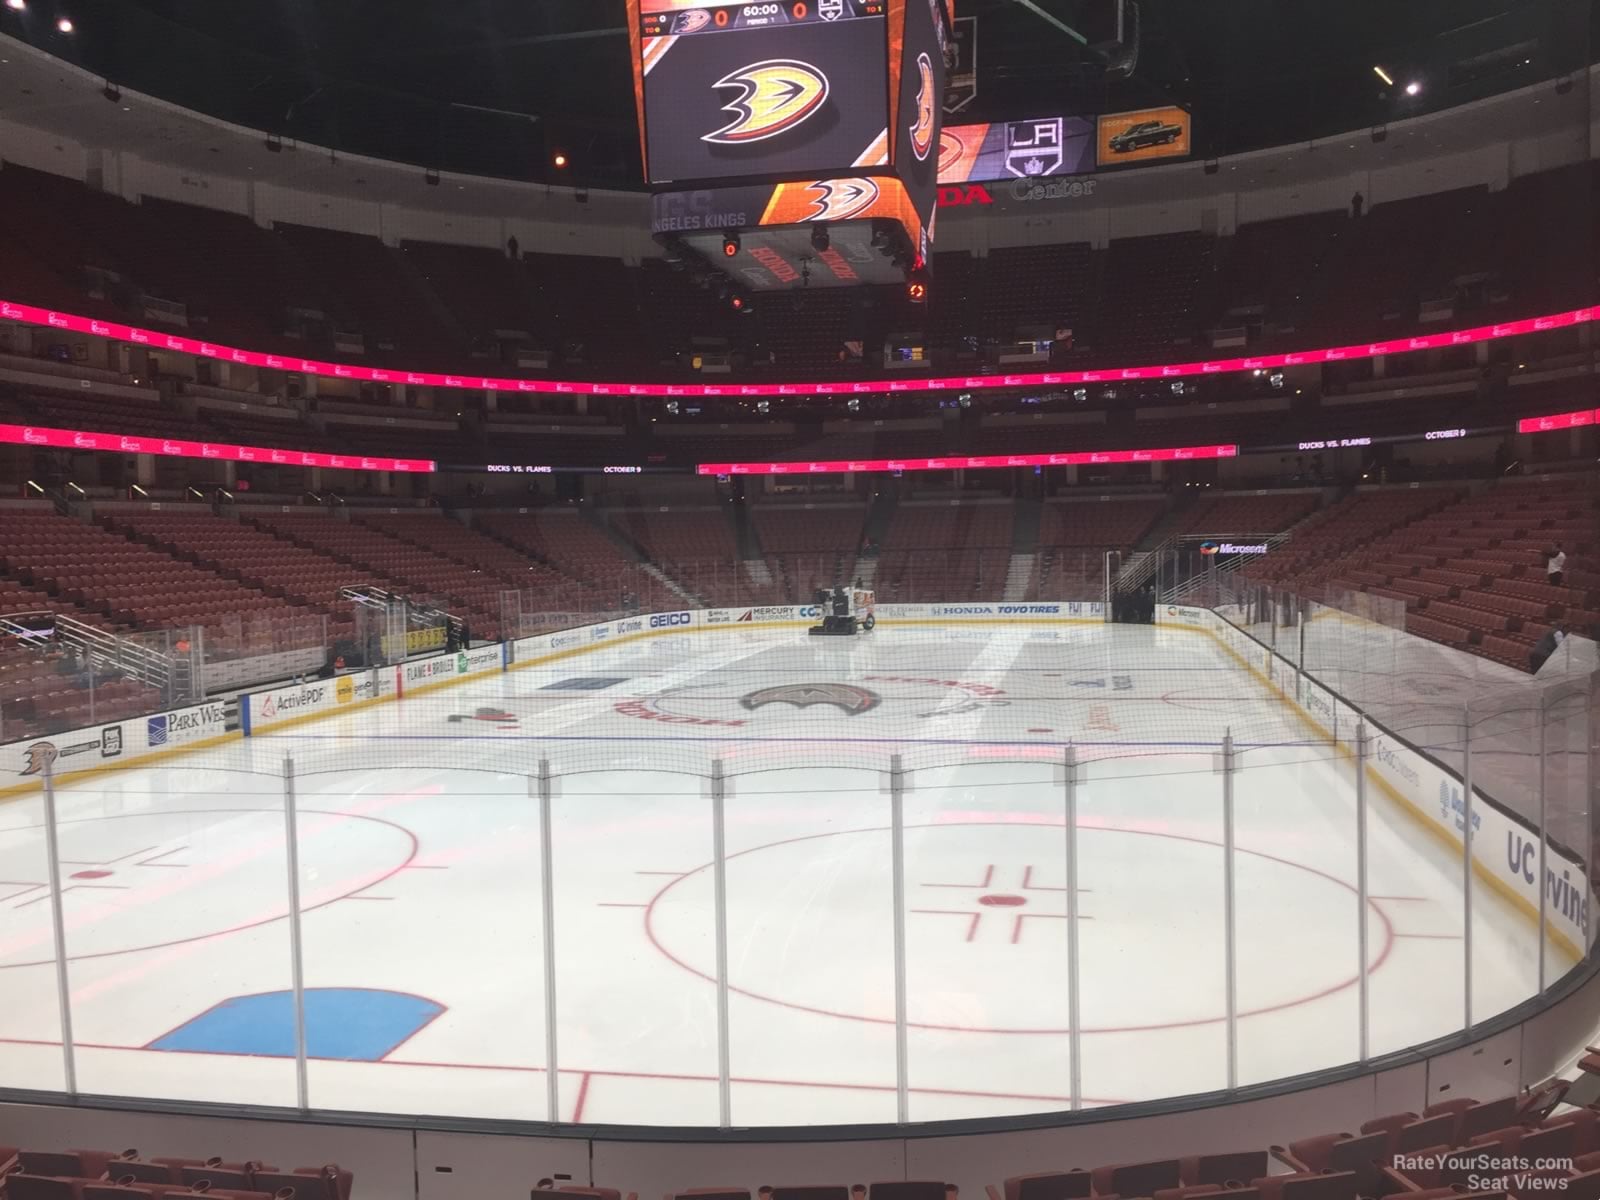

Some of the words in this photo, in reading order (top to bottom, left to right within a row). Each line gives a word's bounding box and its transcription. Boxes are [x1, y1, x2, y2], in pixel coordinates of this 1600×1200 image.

[743, 4, 778, 16] 60:00
[793, 3, 806, 19] 0
[715, 10, 728, 27] 0
[1010, 124, 1057, 147] LA
[705, 212, 746, 228] KINGS
[1299, 442, 1325, 450] DUCKS
[1425, 430, 1459, 440] OCTOBER
[1460, 429, 1466, 437] 9
[488, 464, 510, 472] DUCKS
[753, 607, 794, 615] MERCURY
[943, 606, 993, 615] HONDA
[998, 605, 1028, 614] TOYO
[1029, 605, 1059, 614] TIRES
[650, 613, 690, 628] GEICO
[407, 665, 427, 681] FLAME
[277, 687, 324, 712] ActivePDF
[168, 711, 199, 733] PARK
[1508, 830, 1535, 885] UC
